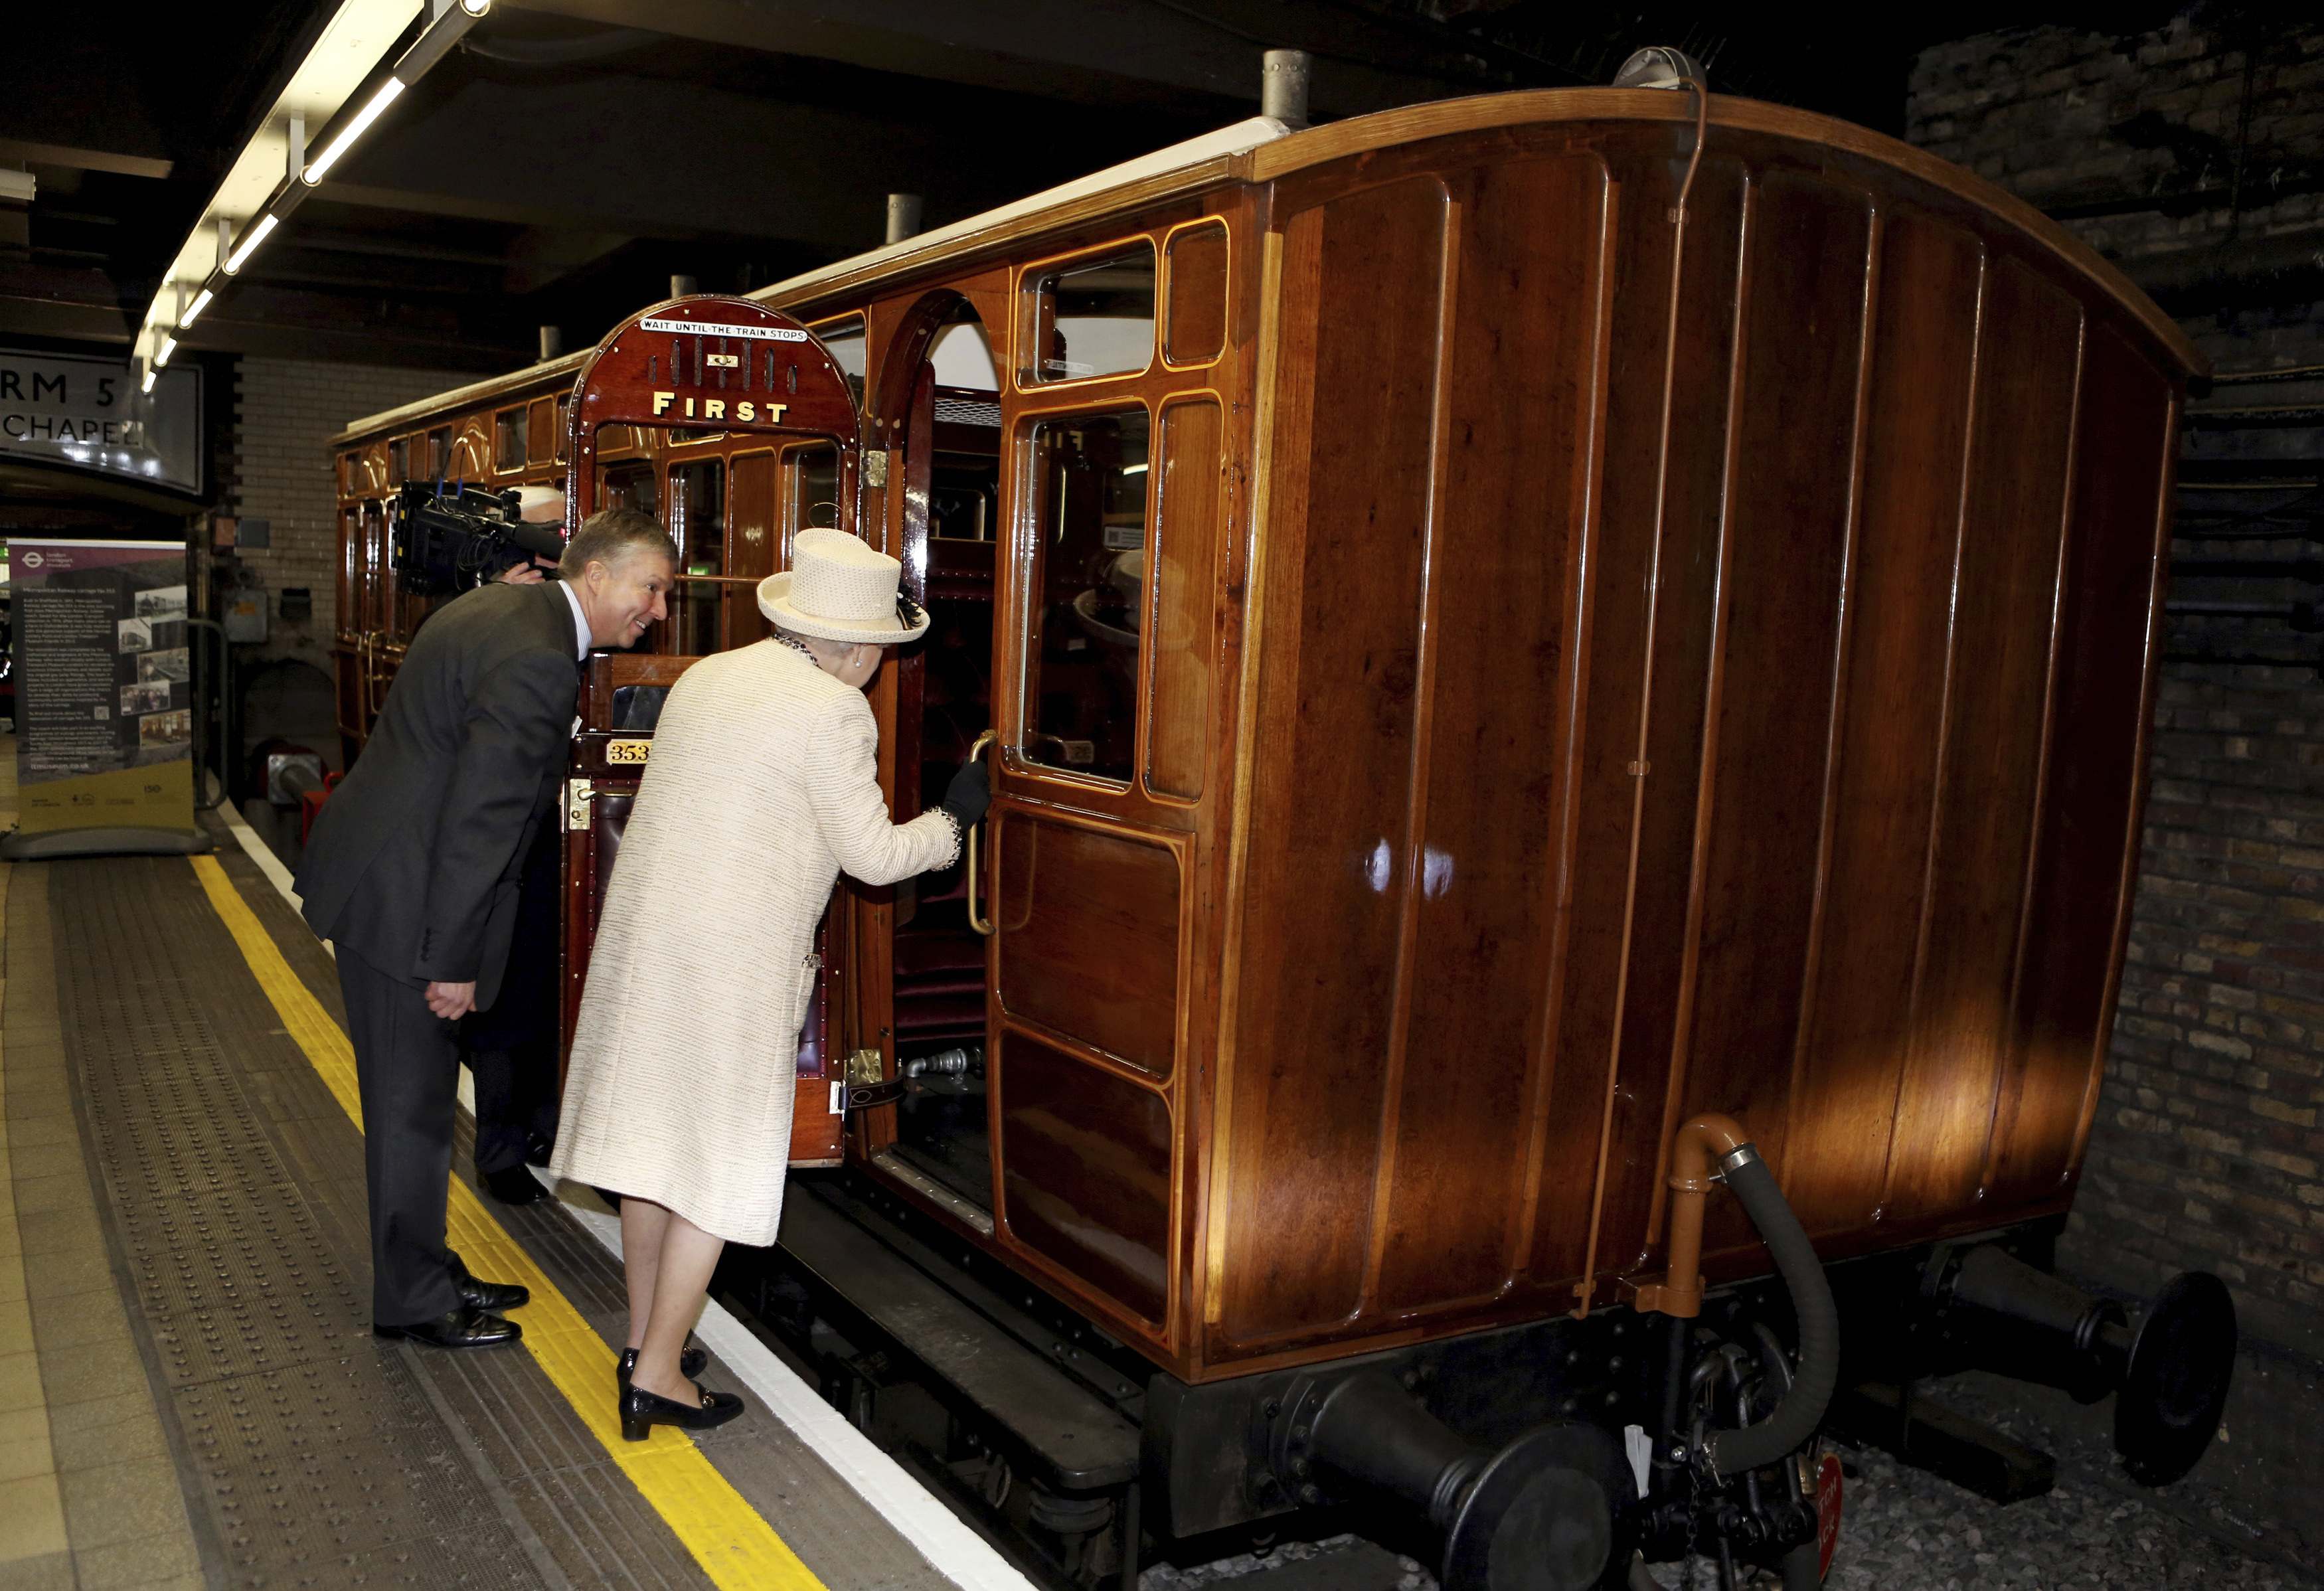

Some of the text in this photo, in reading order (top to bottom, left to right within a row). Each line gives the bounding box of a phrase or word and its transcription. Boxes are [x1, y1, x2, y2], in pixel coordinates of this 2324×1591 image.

[643, 321, 804, 340] WAIT UNTIL THE TRAIN STOPS
[96, 378, 115, 407] 5
[653, 390, 788, 423] FIRST
[612, 745, 649, 761] 353
